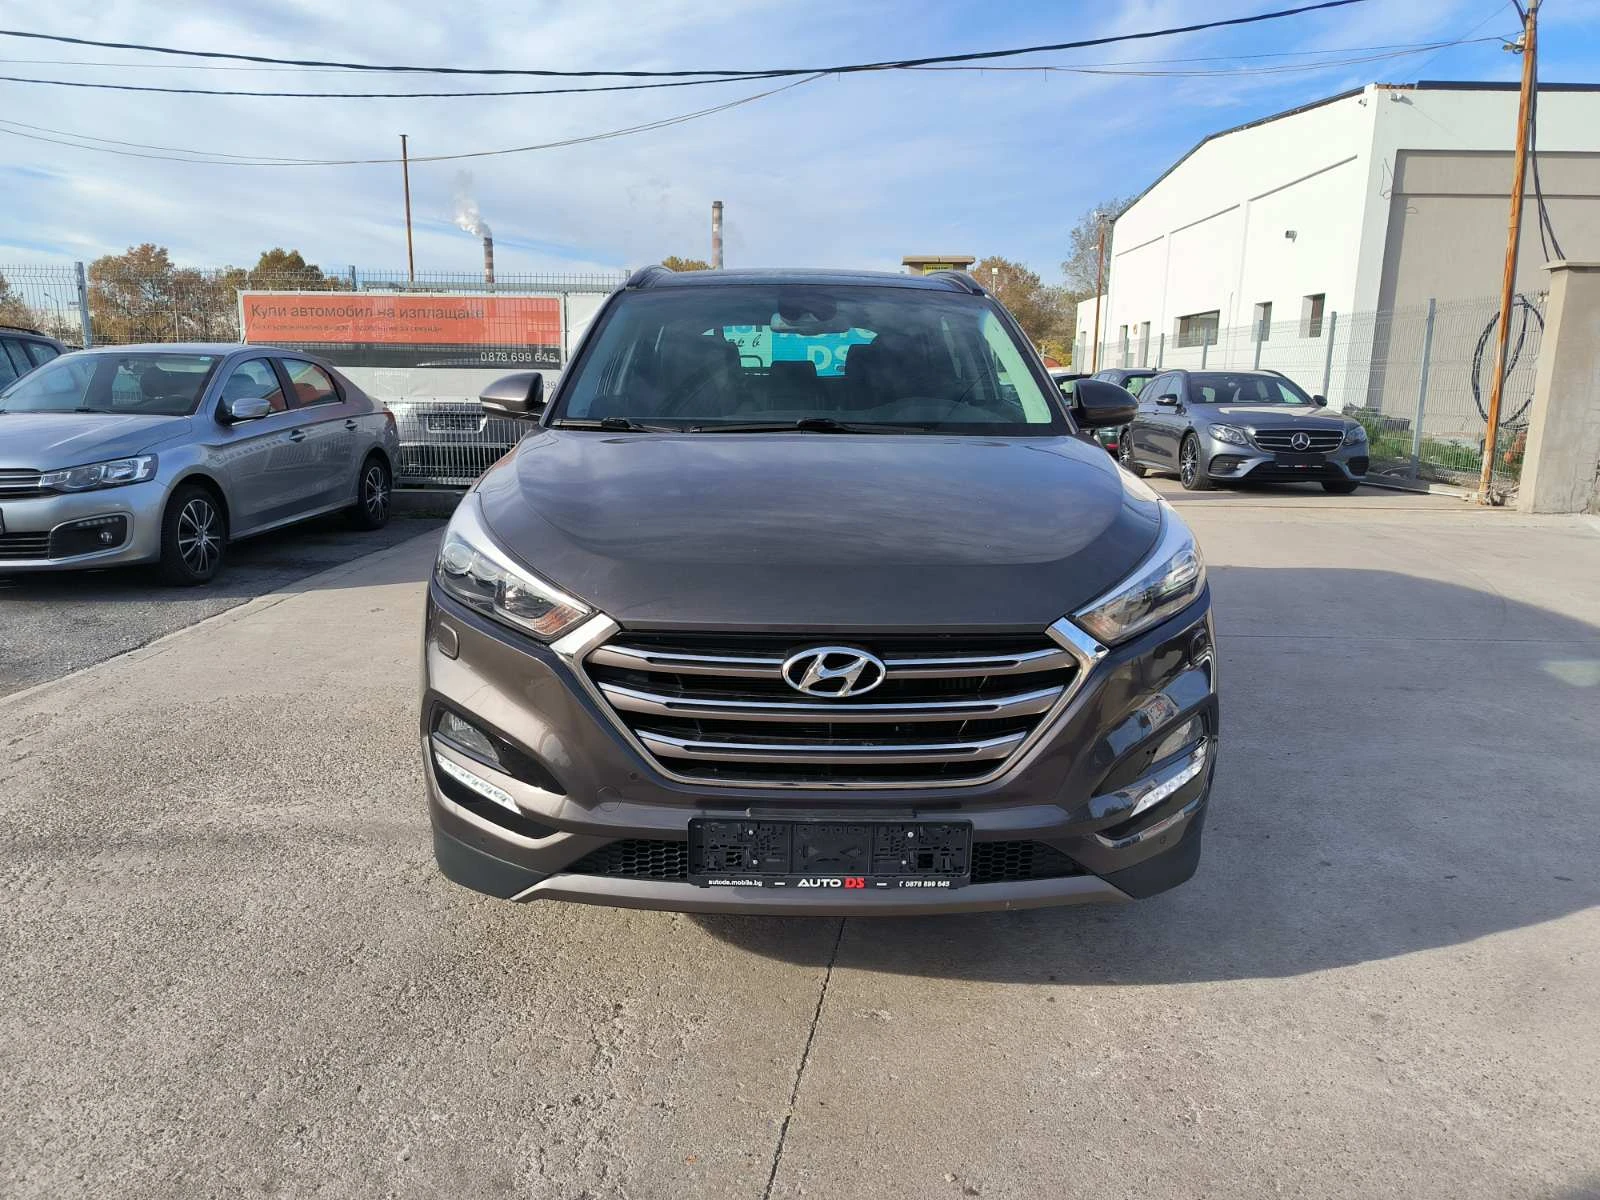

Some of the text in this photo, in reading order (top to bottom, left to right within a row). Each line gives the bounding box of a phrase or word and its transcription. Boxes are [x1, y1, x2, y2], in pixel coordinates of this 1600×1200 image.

[252, 304, 287, 319] Купи
[290, 304, 373, 318] автомобил
[377, 307, 396, 318] на
[480, 352, 508, 362] 0878
[511, 352, 532, 362] 699
[797, 878, 842, 888] AUTO
[844, 878, 865, 889] DS
